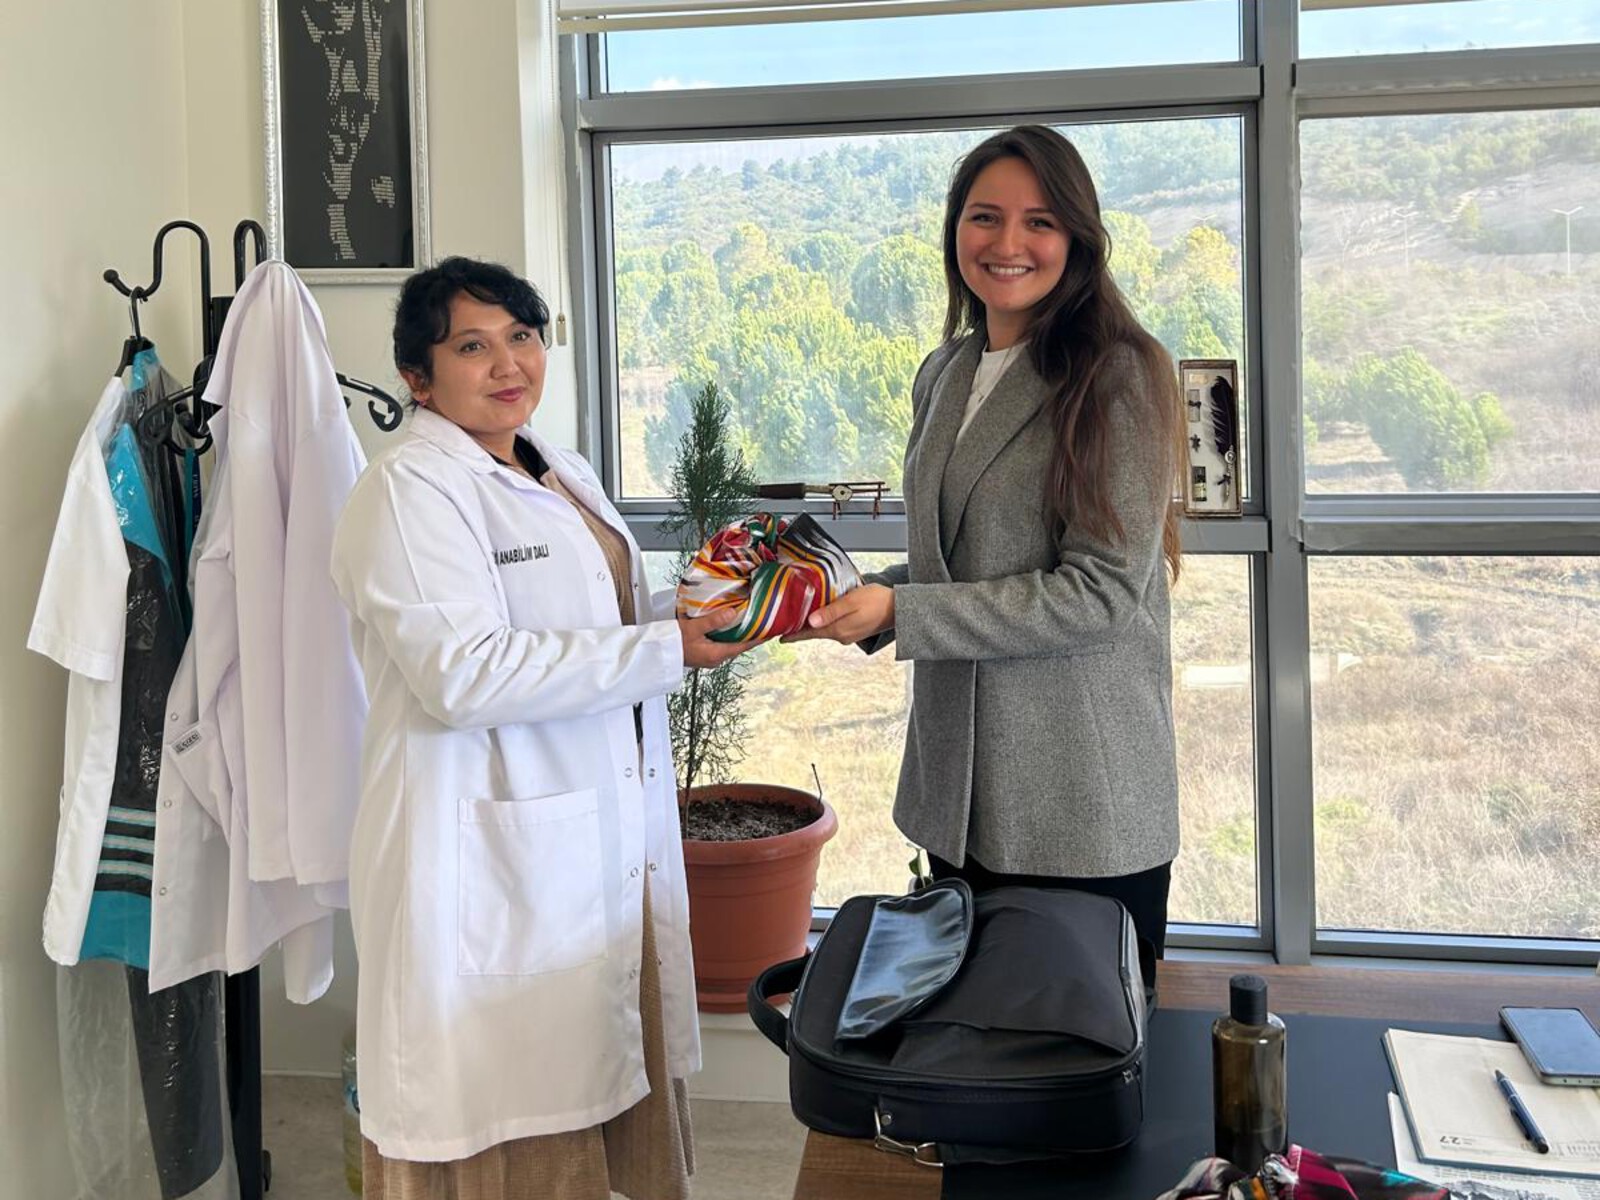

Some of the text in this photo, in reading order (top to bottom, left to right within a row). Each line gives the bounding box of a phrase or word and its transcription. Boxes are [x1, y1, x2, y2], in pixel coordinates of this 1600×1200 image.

[500, 544, 533, 565] ANABİLİM
[533, 543, 550, 560] DALI
[1439, 1135, 1461, 1145] 27
